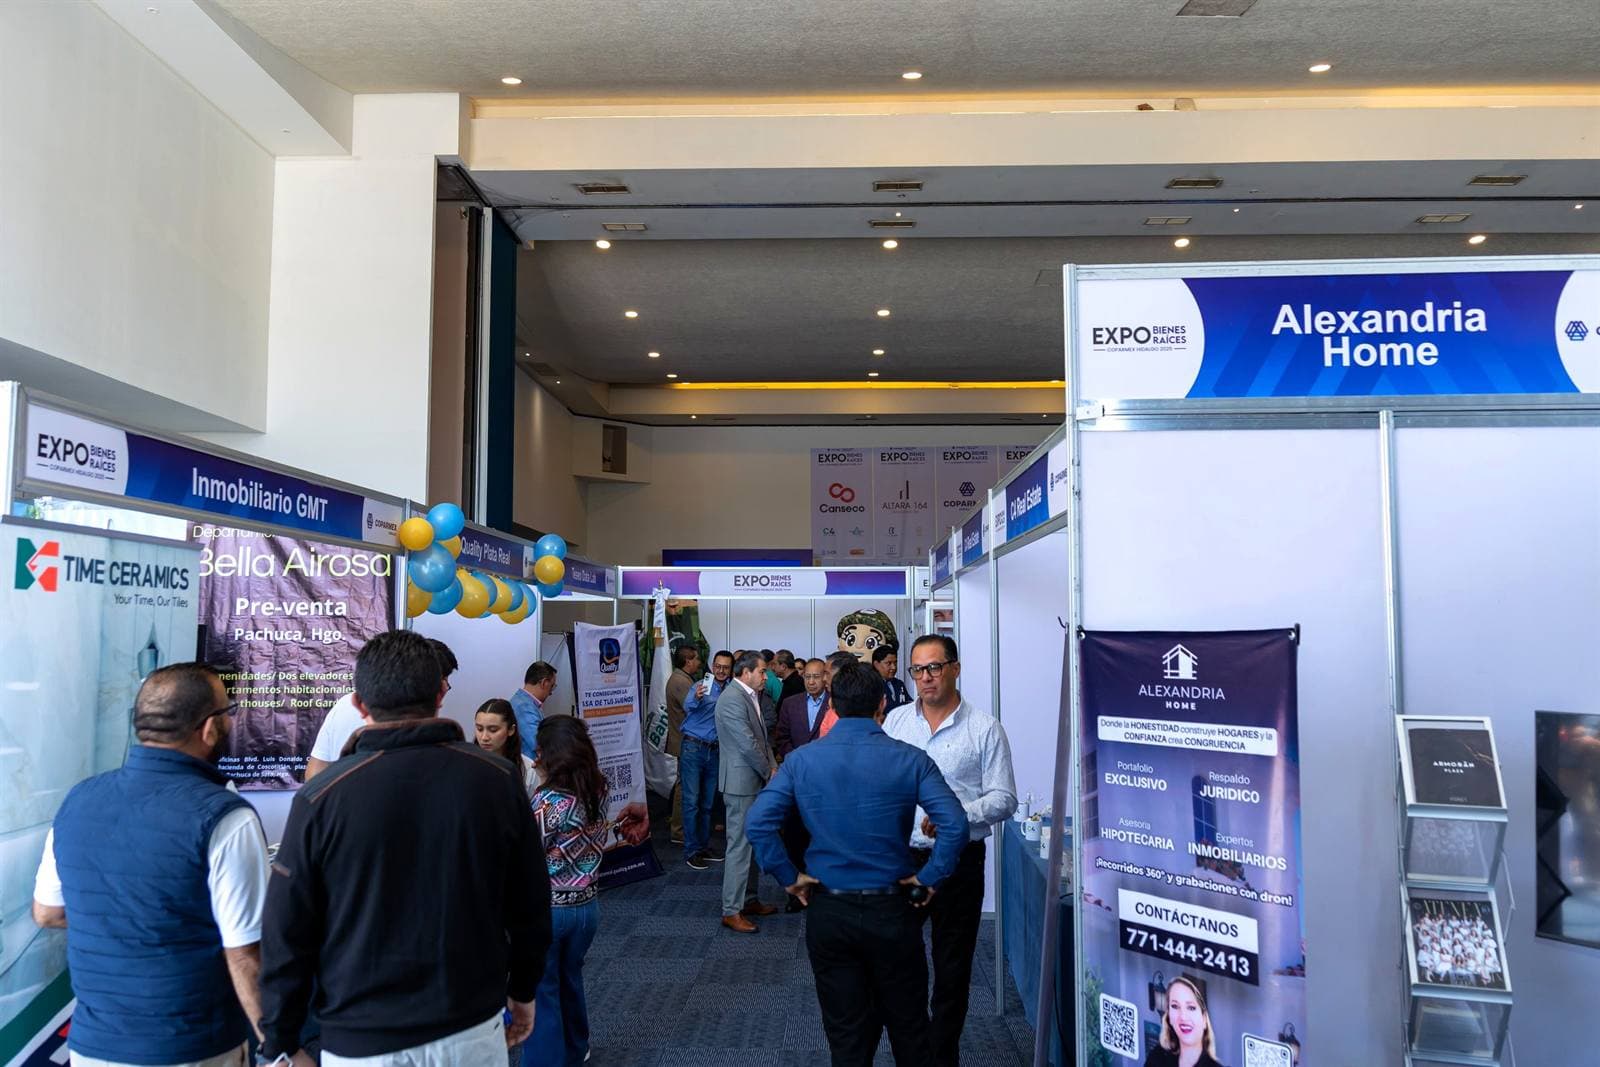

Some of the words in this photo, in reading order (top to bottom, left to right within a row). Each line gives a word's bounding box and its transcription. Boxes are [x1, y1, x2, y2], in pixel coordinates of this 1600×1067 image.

[1271, 301, 1487, 335] Alexandria
[1092, 326, 1151, 344] EXPO
[1152, 326, 1186, 334] BIENES
[1152, 334, 1186, 344] RAÍCES
[1323, 336, 1439, 367] Home
[38, 433, 89, 466] EXPO
[90, 444, 116, 460] BIENES
[818, 453, 846, 463] EXPO
[880, 452, 908, 462] EXPO
[943, 451, 972, 460] EXPO
[192, 467, 292, 514] Inmobiliario
[296, 492, 328, 522] GMT
[1016, 492, 1026, 518] Real
[1026, 484, 1042, 510] Estate
[820, 504, 864, 513] Canseco
[882, 502, 910, 510] ALTARA
[914, 502, 928, 510] 164
[461, 536, 482, 562] Quality
[484, 543, 498, 562] Plata
[282, 546, 391, 577] Airosa
[64, 555, 105, 584] TIME
[108, 561, 190, 590] CERAMICS
[734, 574, 770, 587] EXPO
[114, 593, 132, 605] Your
[134, 594, 155, 606] Time,
[156, 596, 170, 607] Our
[172, 596, 188, 608] Tiles
[236, 598, 347, 616] Pre-venta
[234, 628, 306, 642] Pachuca,
[312, 628, 346, 644] Hgo.
[278, 672, 297, 680] Dos
[300, 672, 354, 680] elevadores
[226, 685, 281, 694] rtamentos
[284, 684, 355, 694] habitacionales
[1138, 684, 1226, 700] ALEXANDRIA
[240, 698, 286, 708] thouses/
[290, 698, 314, 708] Roof
[1166, 702, 1196, 710] HOME
[1100, 718, 1122, 728] Donde
[1124, 720, 1130, 728] la
[1130, 722, 1180, 733] HONESTIDAD
[1180, 726, 1216, 736] construye
[1218, 728, 1259, 739] HOGARES
[1266, 732, 1272, 740] la
[1124, 732, 1167, 744] CONFIANZA
[1168, 736, 1184, 745] crea
[1184, 738, 1246, 750] CONGRUENCIA
[1118, 760, 1154, 774] Portafolio
[1104, 773, 1168, 791] EXCLUSIVO
[1209, 772, 1250, 786] Respaldo
[1200, 785, 1260, 804] JURIDICO
[1101, 828, 1174, 850] HIPOTECARIA
[1216, 832, 1254, 848] Expertos
[1188, 842, 1287, 870] INMOBILIARIOS
[1096, 856, 1144, 876] ¡Recorridos
[1145, 868, 1166, 880] 360°
[1166, 872, 1173, 884] y
[1176, 873, 1238, 895] grabaciones
[1240, 887, 1258, 900] con
[1260, 892, 1293, 906] dron!
[1134, 902, 1239, 938] CONTÁCTANOS
[1126, 927, 1250, 977] 771-444-2413
